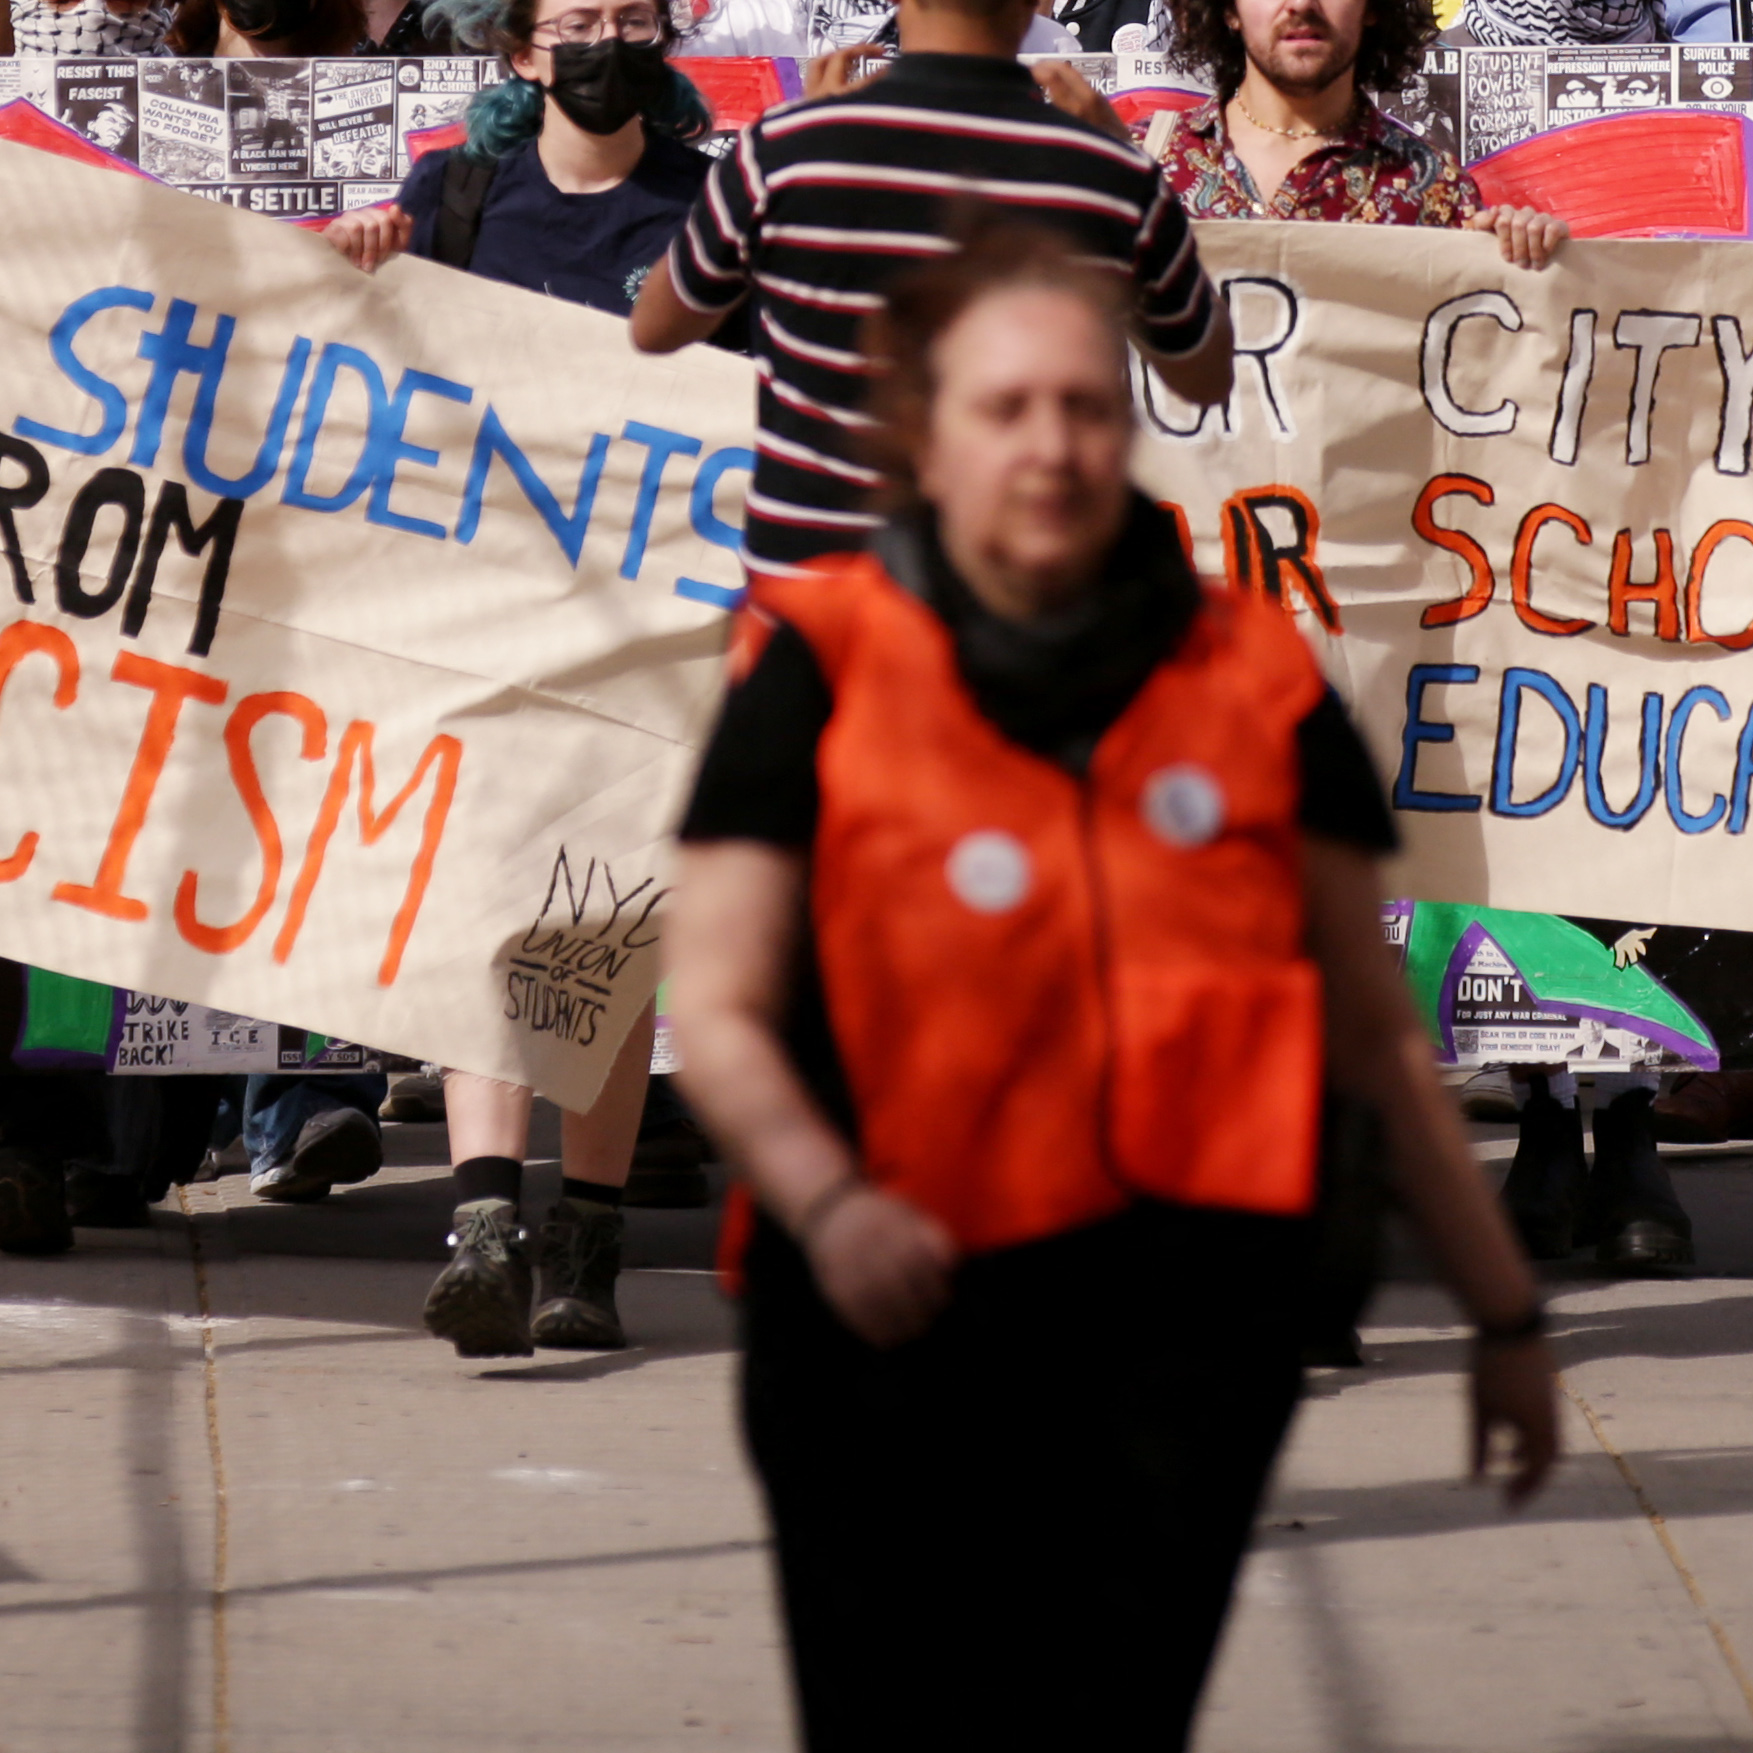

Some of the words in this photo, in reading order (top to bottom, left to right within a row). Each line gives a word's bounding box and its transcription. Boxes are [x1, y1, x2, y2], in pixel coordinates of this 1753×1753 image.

[1683, 49, 1727, 61] SURVEIL
[1730, 49, 1750, 61] THE
[423, 59, 447, 70] END
[450, 59, 474, 70] THE
[1468, 53, 1543, 74] STUDENT
[1548, 61, 1606, 74] REPRESSION
[1608, 60, 1670, 73] EVERYWHERE
[1698, 62, 1735, 75] POLICE
[56, 66, 102, 79] RESIST
[105, 65, 136, 79] THIS
[423, 71, 440, 81] US
[442, 71, 474, 81] WAR
[68, 86, 125, 101] FASCIST
[350, 84, 390, 98] STUDENTS
[420, 81, 476, 92] MACHINE
[348, 95, 384, 110] UNITED
[1492, 93, 1523, 109] NOT
[149, 98, 219, 126] COLUMBIA
[142, 106, 191, 127] WANTS
[197, 120, 224, 137] YOU
[318, 121, 336, 131] WILL
[338, 115, 364, 126] NEVER
[1469, 109, 1536, 132] CORPORATE
[142, 117, 160, 129] TO
[163, 123, 218, 145] FORGET
[333, 123, 386, 145] DEFEATED
[240, 149, 267, 159] BLACK
[268, 149, 287, 159] MAN
[288, 148, 308, 158] WAS
[278, 161, 299, 171] HERE
[250, 187, 335, 211] SETTLE
[523, 844, 673, 952] NYC
[551, 966, 576, 984] OF
[1457, 976, 1523, 1002] DON'T
[1456, 1010, 1472, 1019] FOR
[1474, 1010, 1493, 1019] JUST
[1494, 1011, 1511, 1019] ANY
[1512, 1011, 1530, 1020] WAR
[118, 1044, 175, 1066] BACK!
